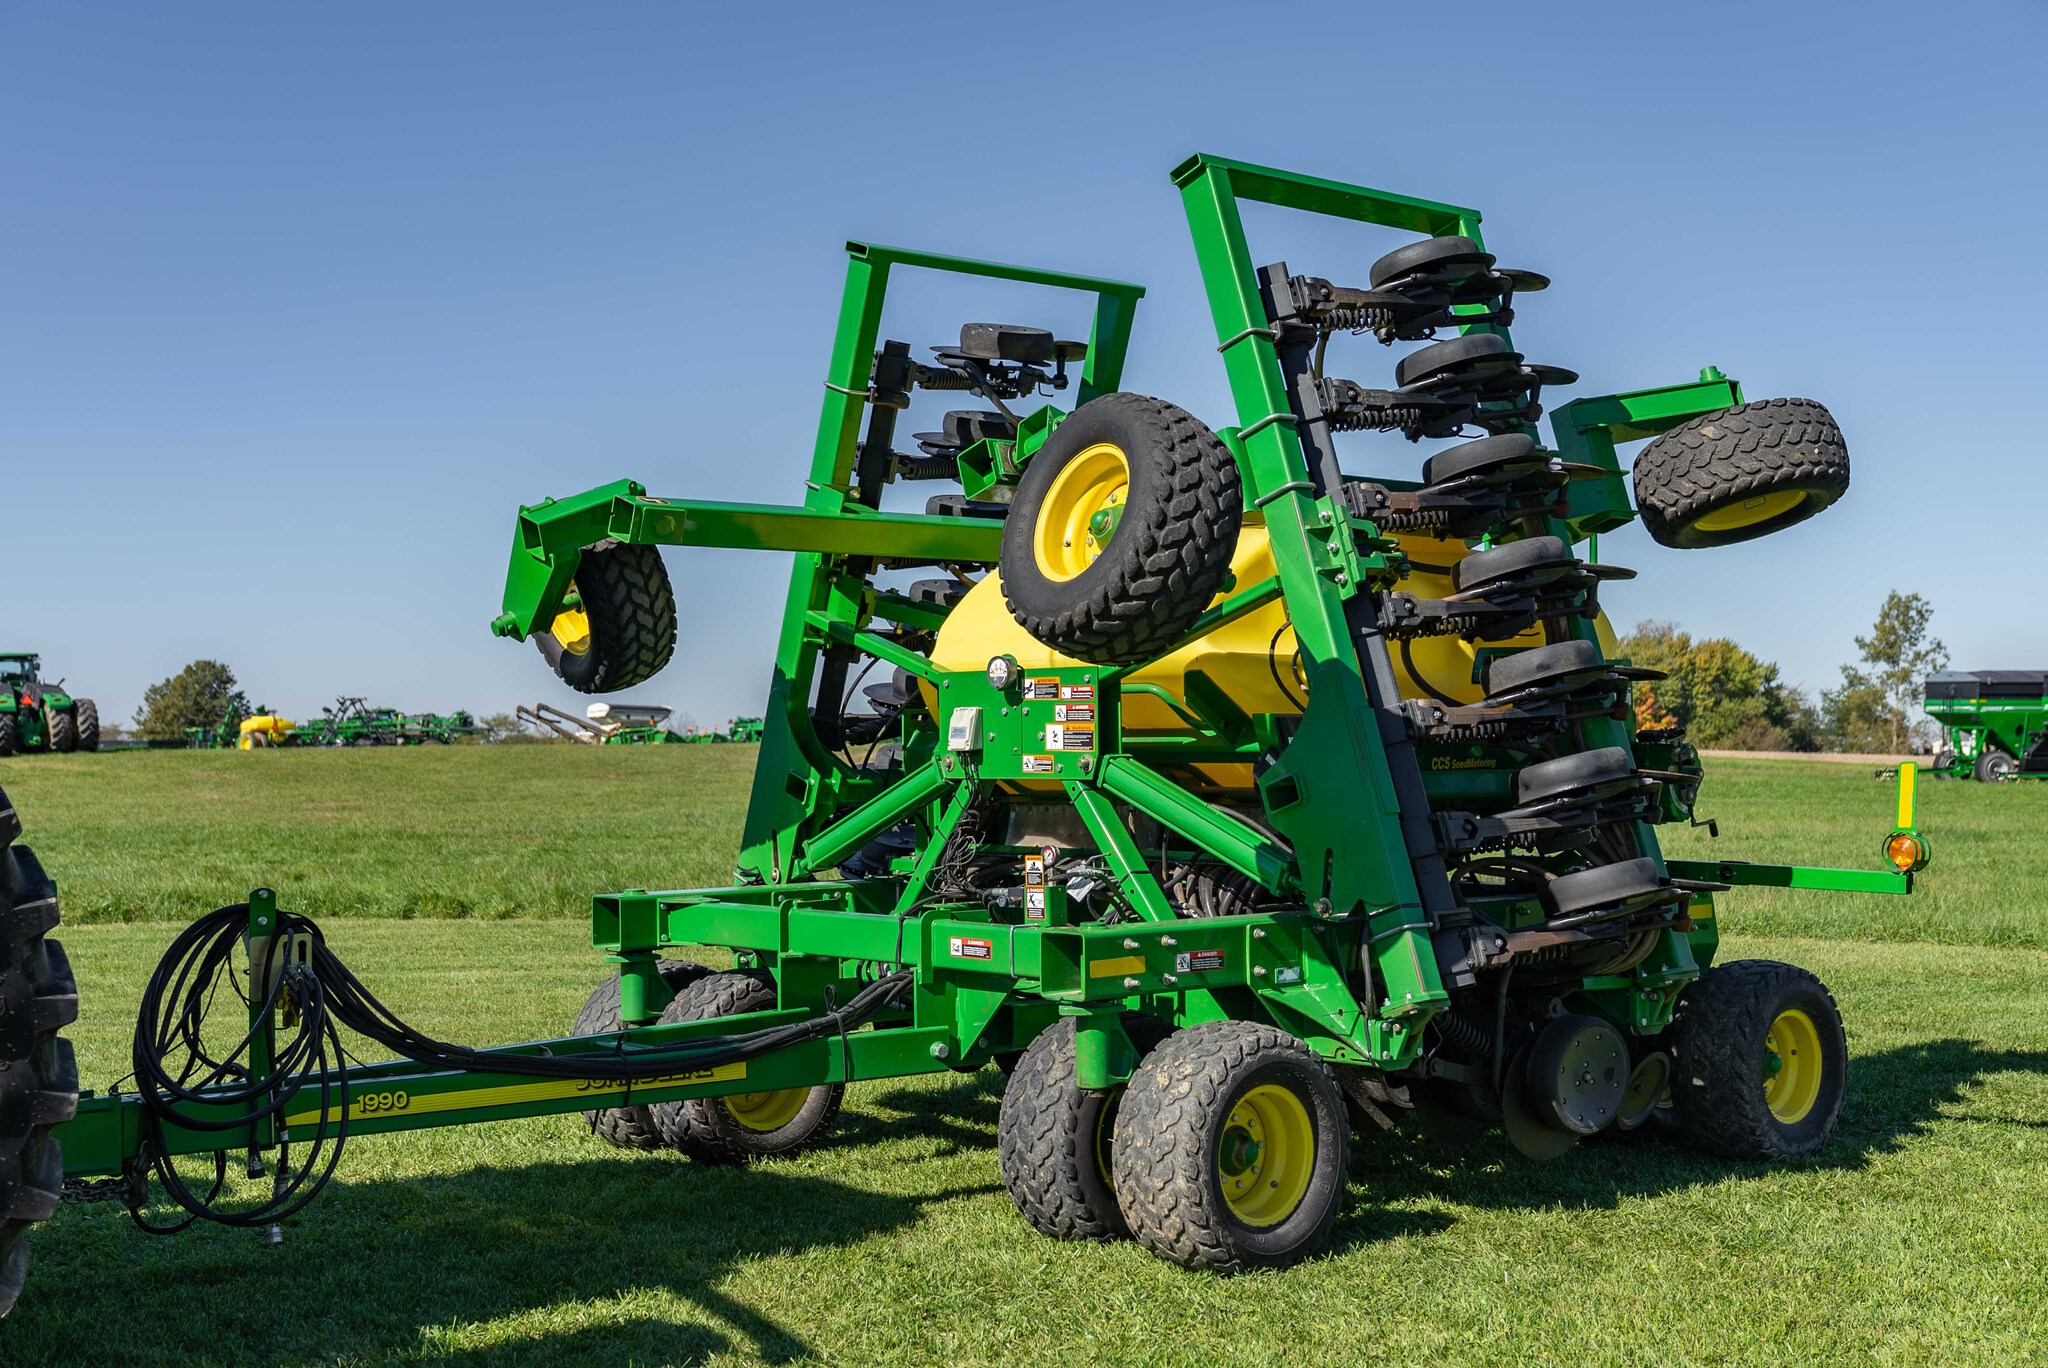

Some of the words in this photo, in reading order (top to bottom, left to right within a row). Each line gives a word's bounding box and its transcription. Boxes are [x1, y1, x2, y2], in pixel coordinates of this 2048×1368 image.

[1431, 756, 1450, 769] CCS
[1451, 757, 1496, 769] SeedMetering
[356, 1090, 409, 1112] 1990
